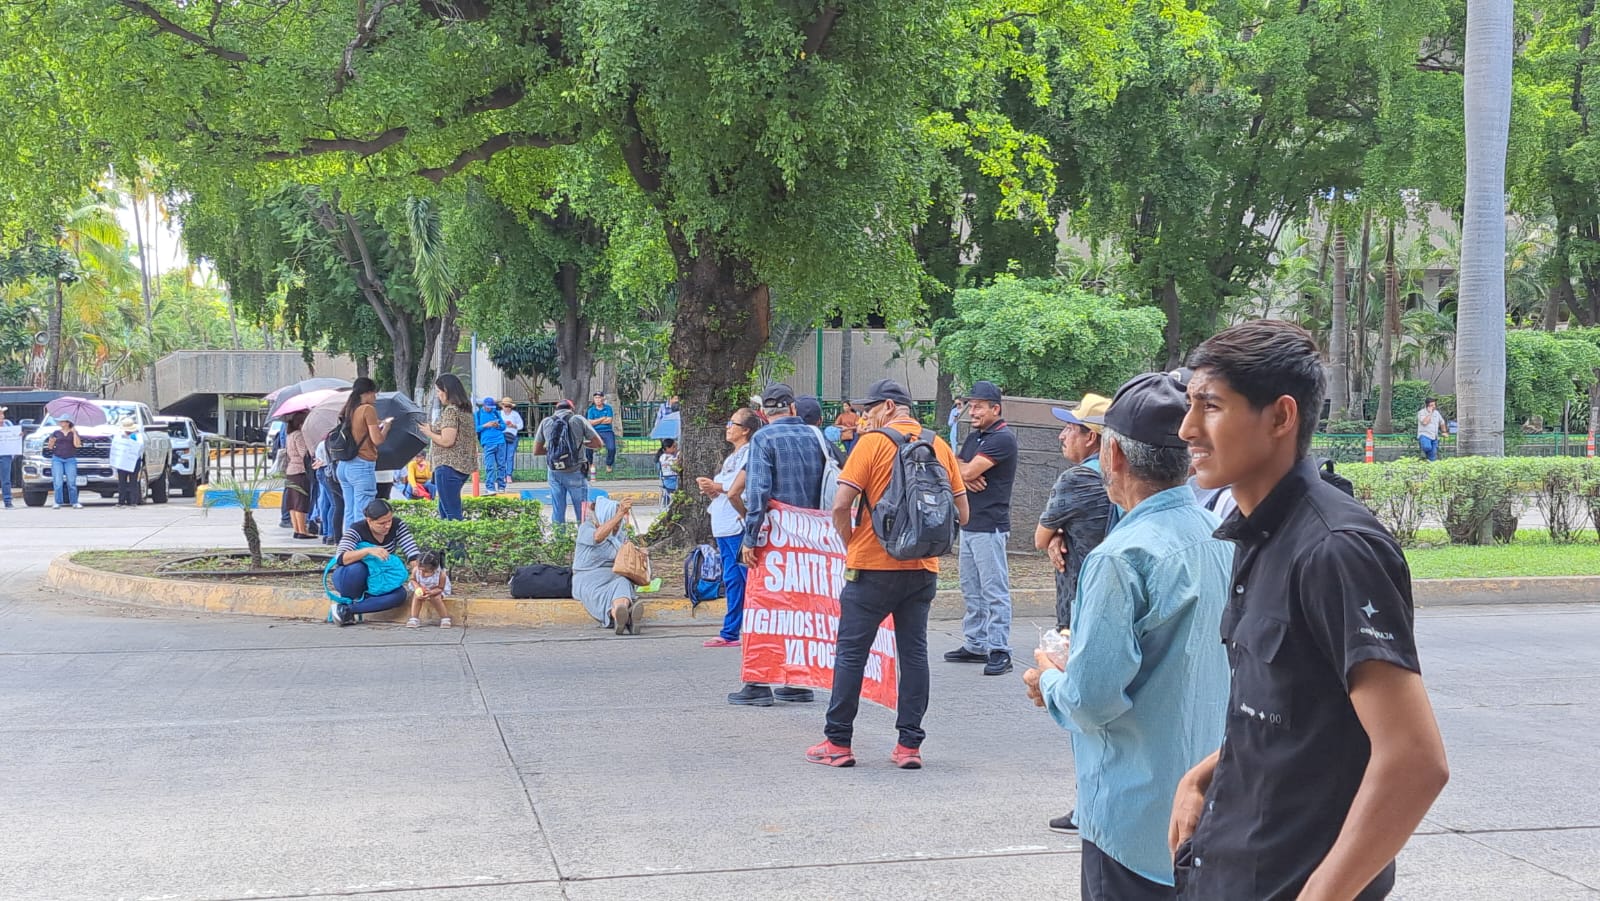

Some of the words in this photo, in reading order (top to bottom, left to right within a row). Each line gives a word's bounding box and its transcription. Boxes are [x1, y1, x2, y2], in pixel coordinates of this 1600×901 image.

[764, 550, 830, 597] SANTA
[815, 613, 829, 639] EL
[784, 639, 806, 666] YA
